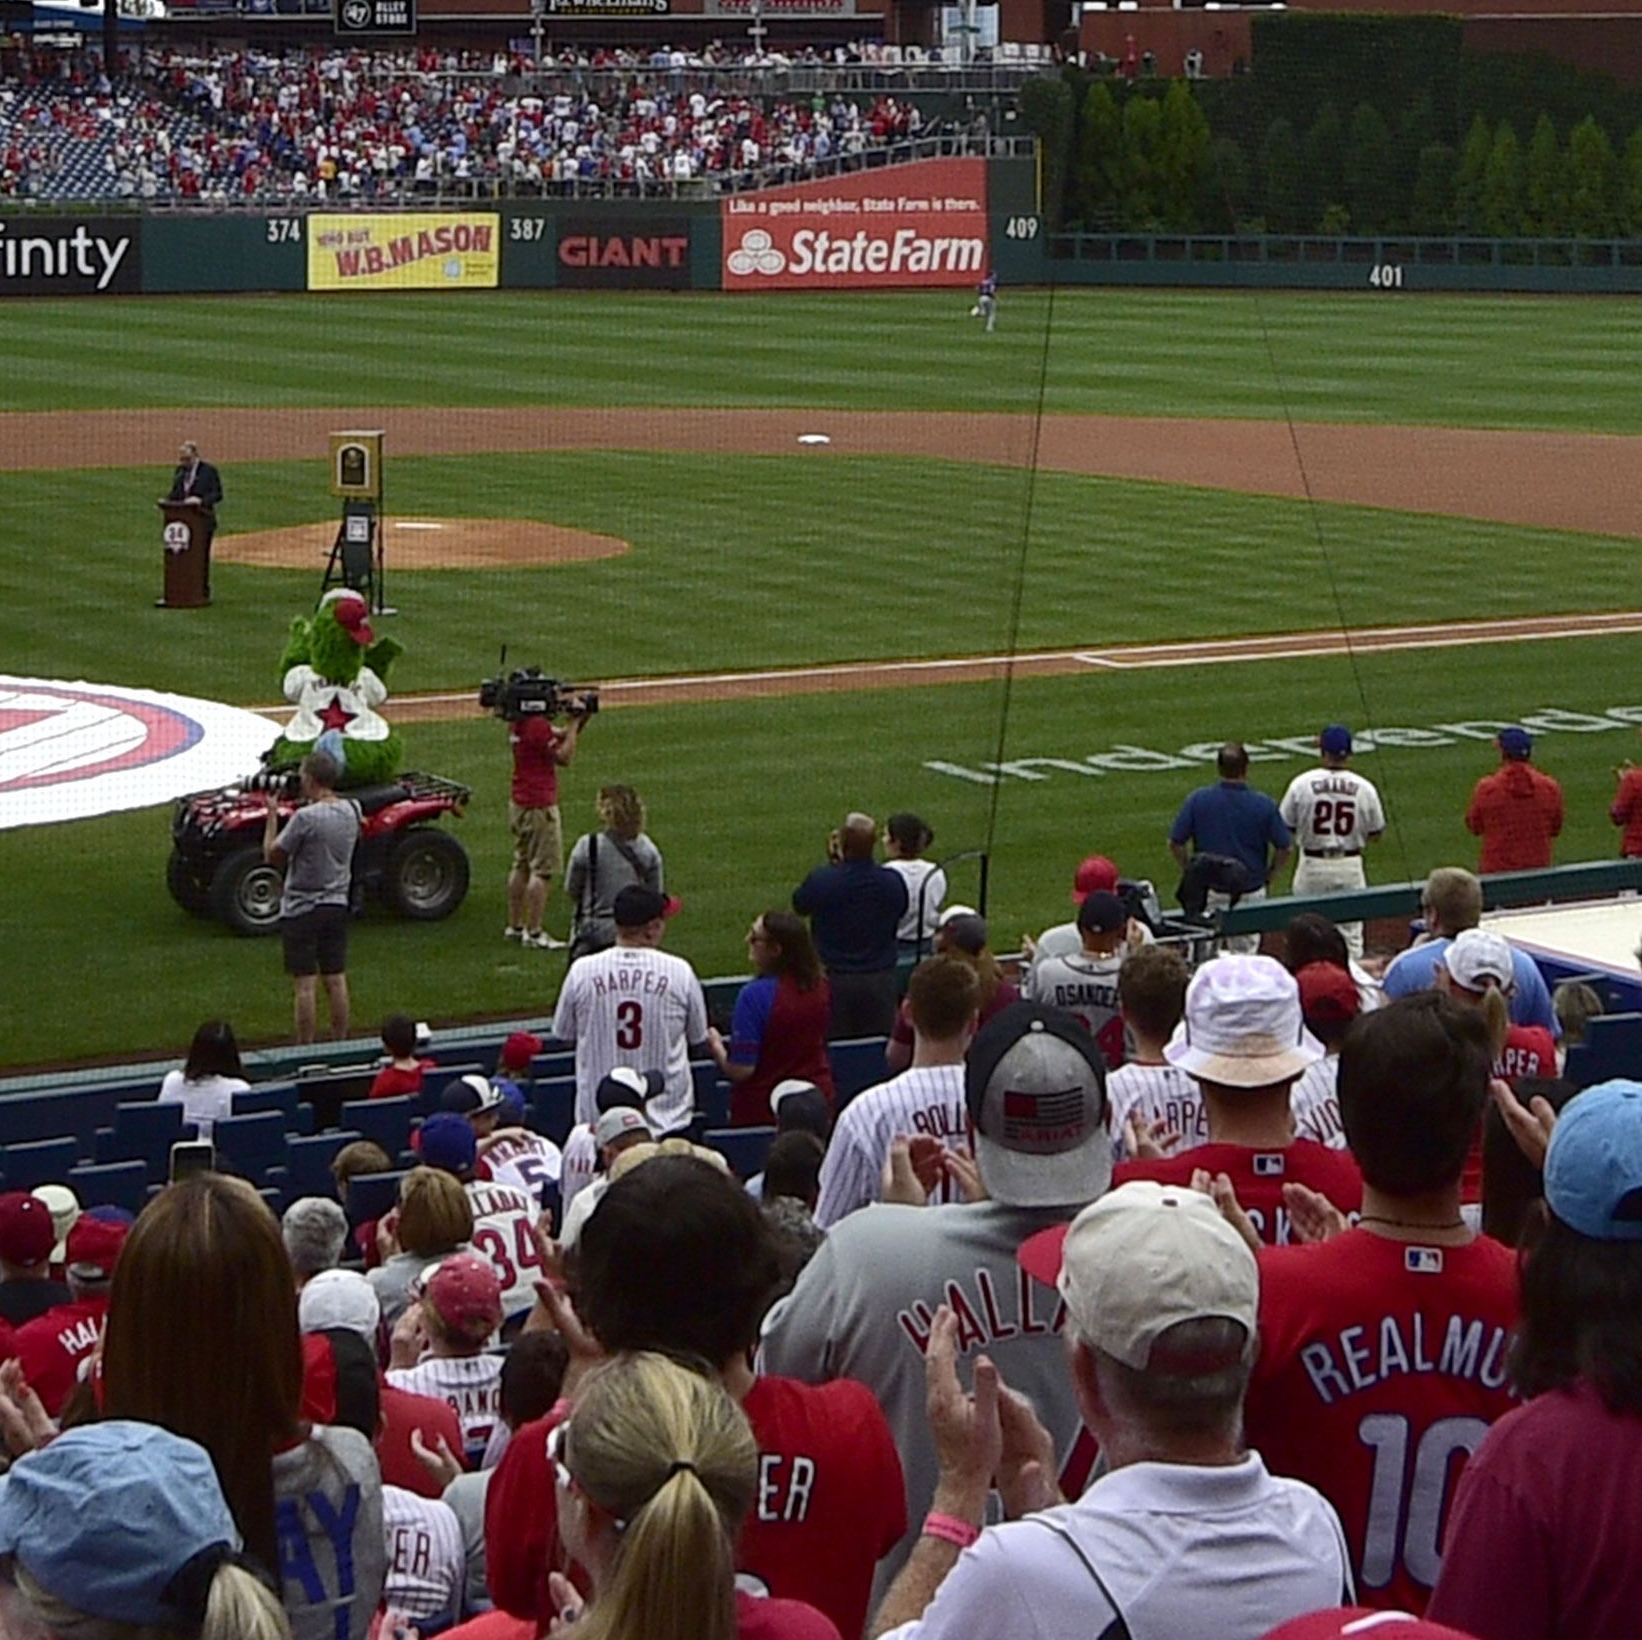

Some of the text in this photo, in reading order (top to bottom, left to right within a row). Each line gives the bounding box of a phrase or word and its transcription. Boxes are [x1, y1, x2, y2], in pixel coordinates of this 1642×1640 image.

[730, 198, 755, 214] Like
[758, 203, 767, 213] a
[863, 197, 895, 213] State
[897, 197, 930, 212] Farm
[267, 219, 301, 242] 374
[510, 218, 545, 241] 387
[1006, 217, 1038, 240] 409
[560, 237, 688, 268] GIANT
[1369, 262, 1404, 289] 401
[592, 973, 671, 1000] HARPER
[615, 1000, 644, 1051] 3
